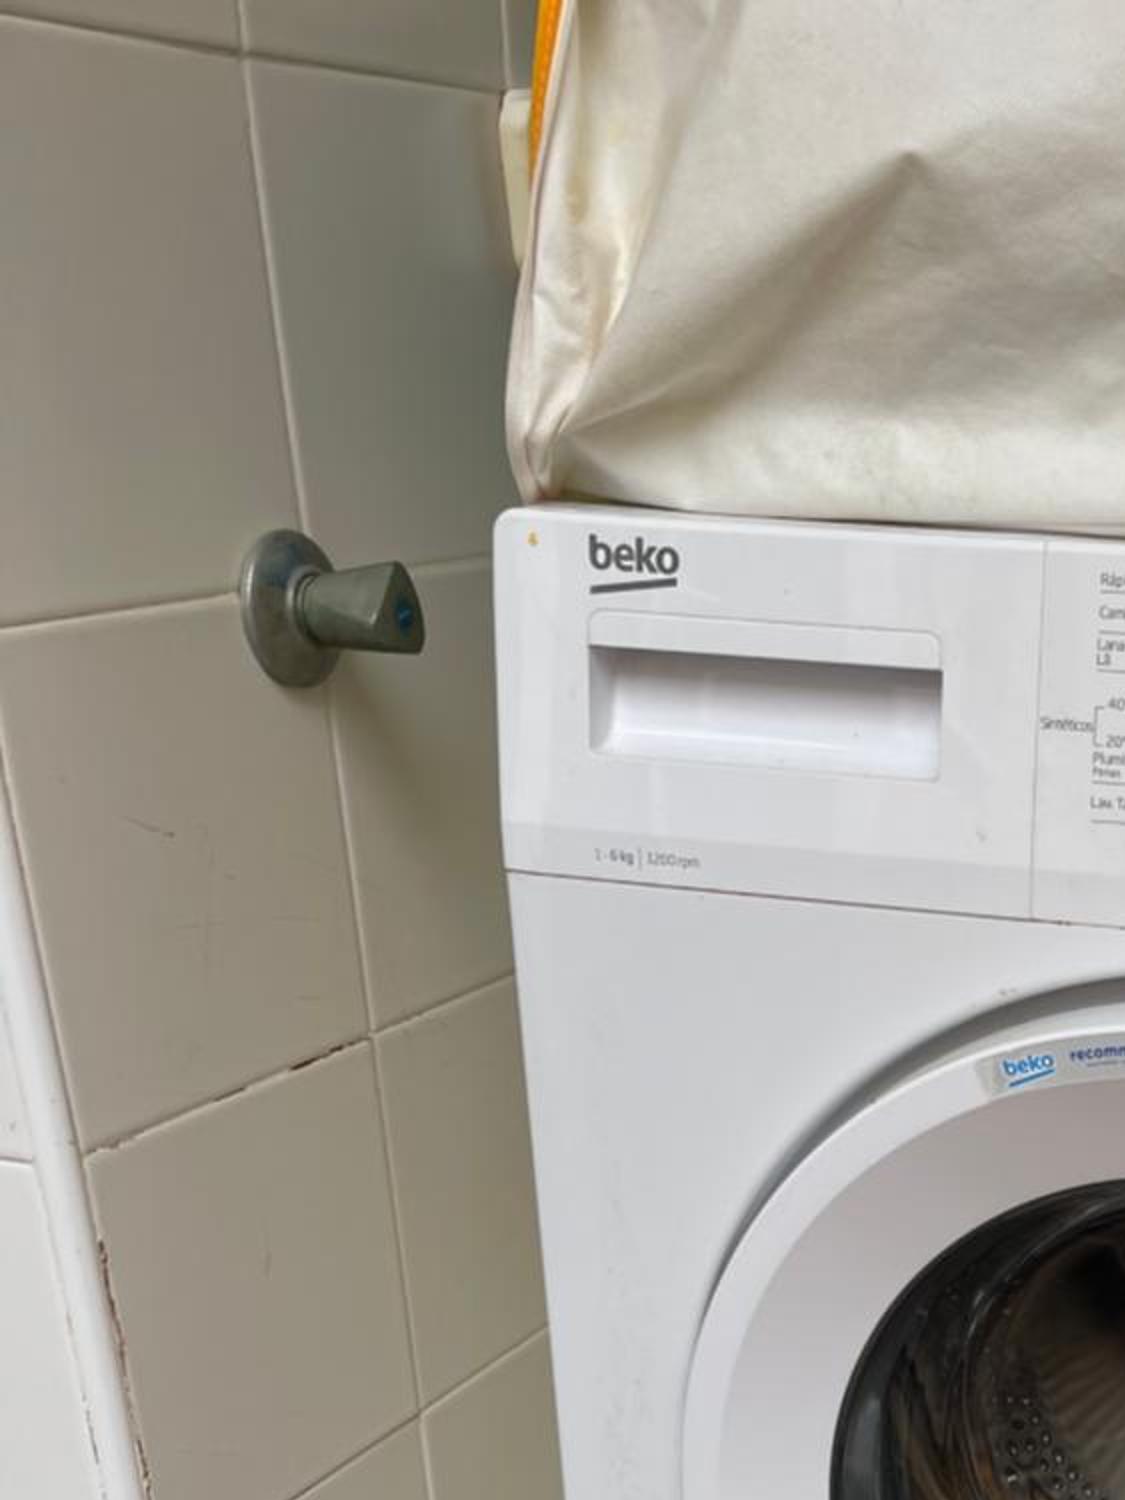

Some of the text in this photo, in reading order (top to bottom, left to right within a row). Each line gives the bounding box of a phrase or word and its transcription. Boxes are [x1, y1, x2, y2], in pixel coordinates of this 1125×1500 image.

[588, 533, 680, 576] beko
[1097, 638, 1125, 652] Lana
[1003, 1054, 1055, 1077] beko
